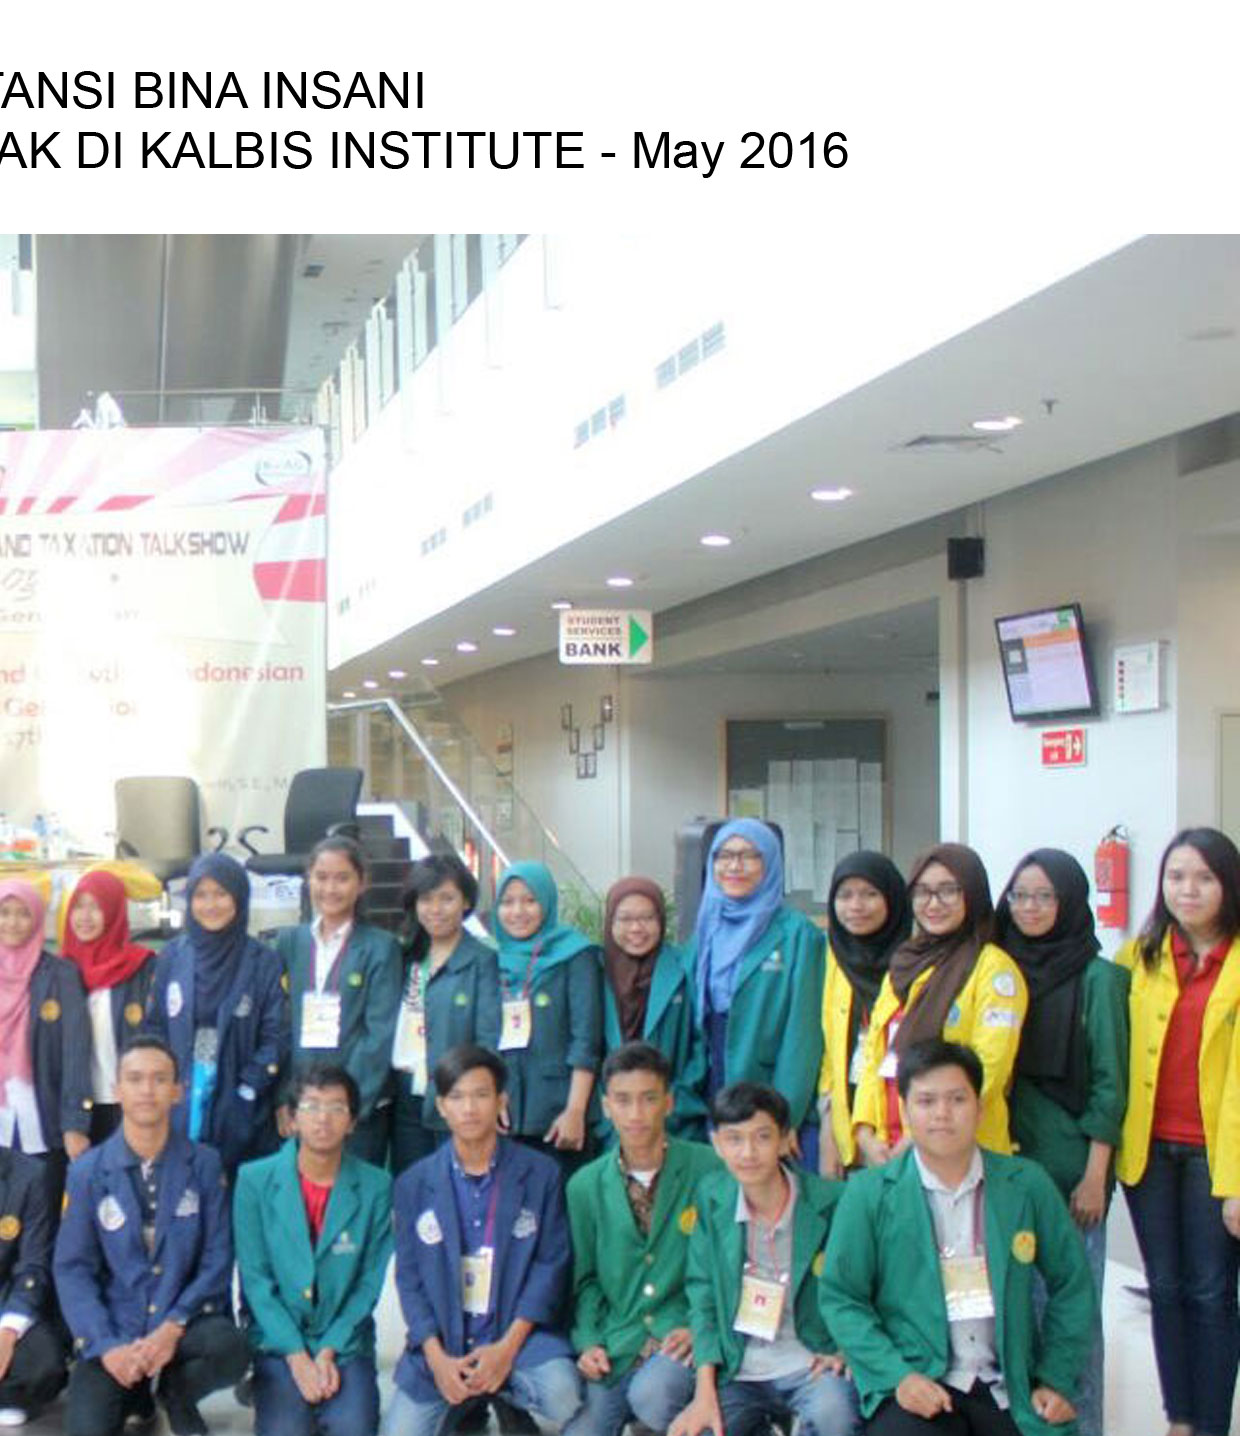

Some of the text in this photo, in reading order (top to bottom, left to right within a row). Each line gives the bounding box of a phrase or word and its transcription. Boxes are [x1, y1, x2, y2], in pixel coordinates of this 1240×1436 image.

[140, 531, 250, 556] TALKSHOW
[567, 616, 620, 625] STUDENT
[566, 626, 622, 636] SERVICES
[565, 642, 621, 657] BANK
